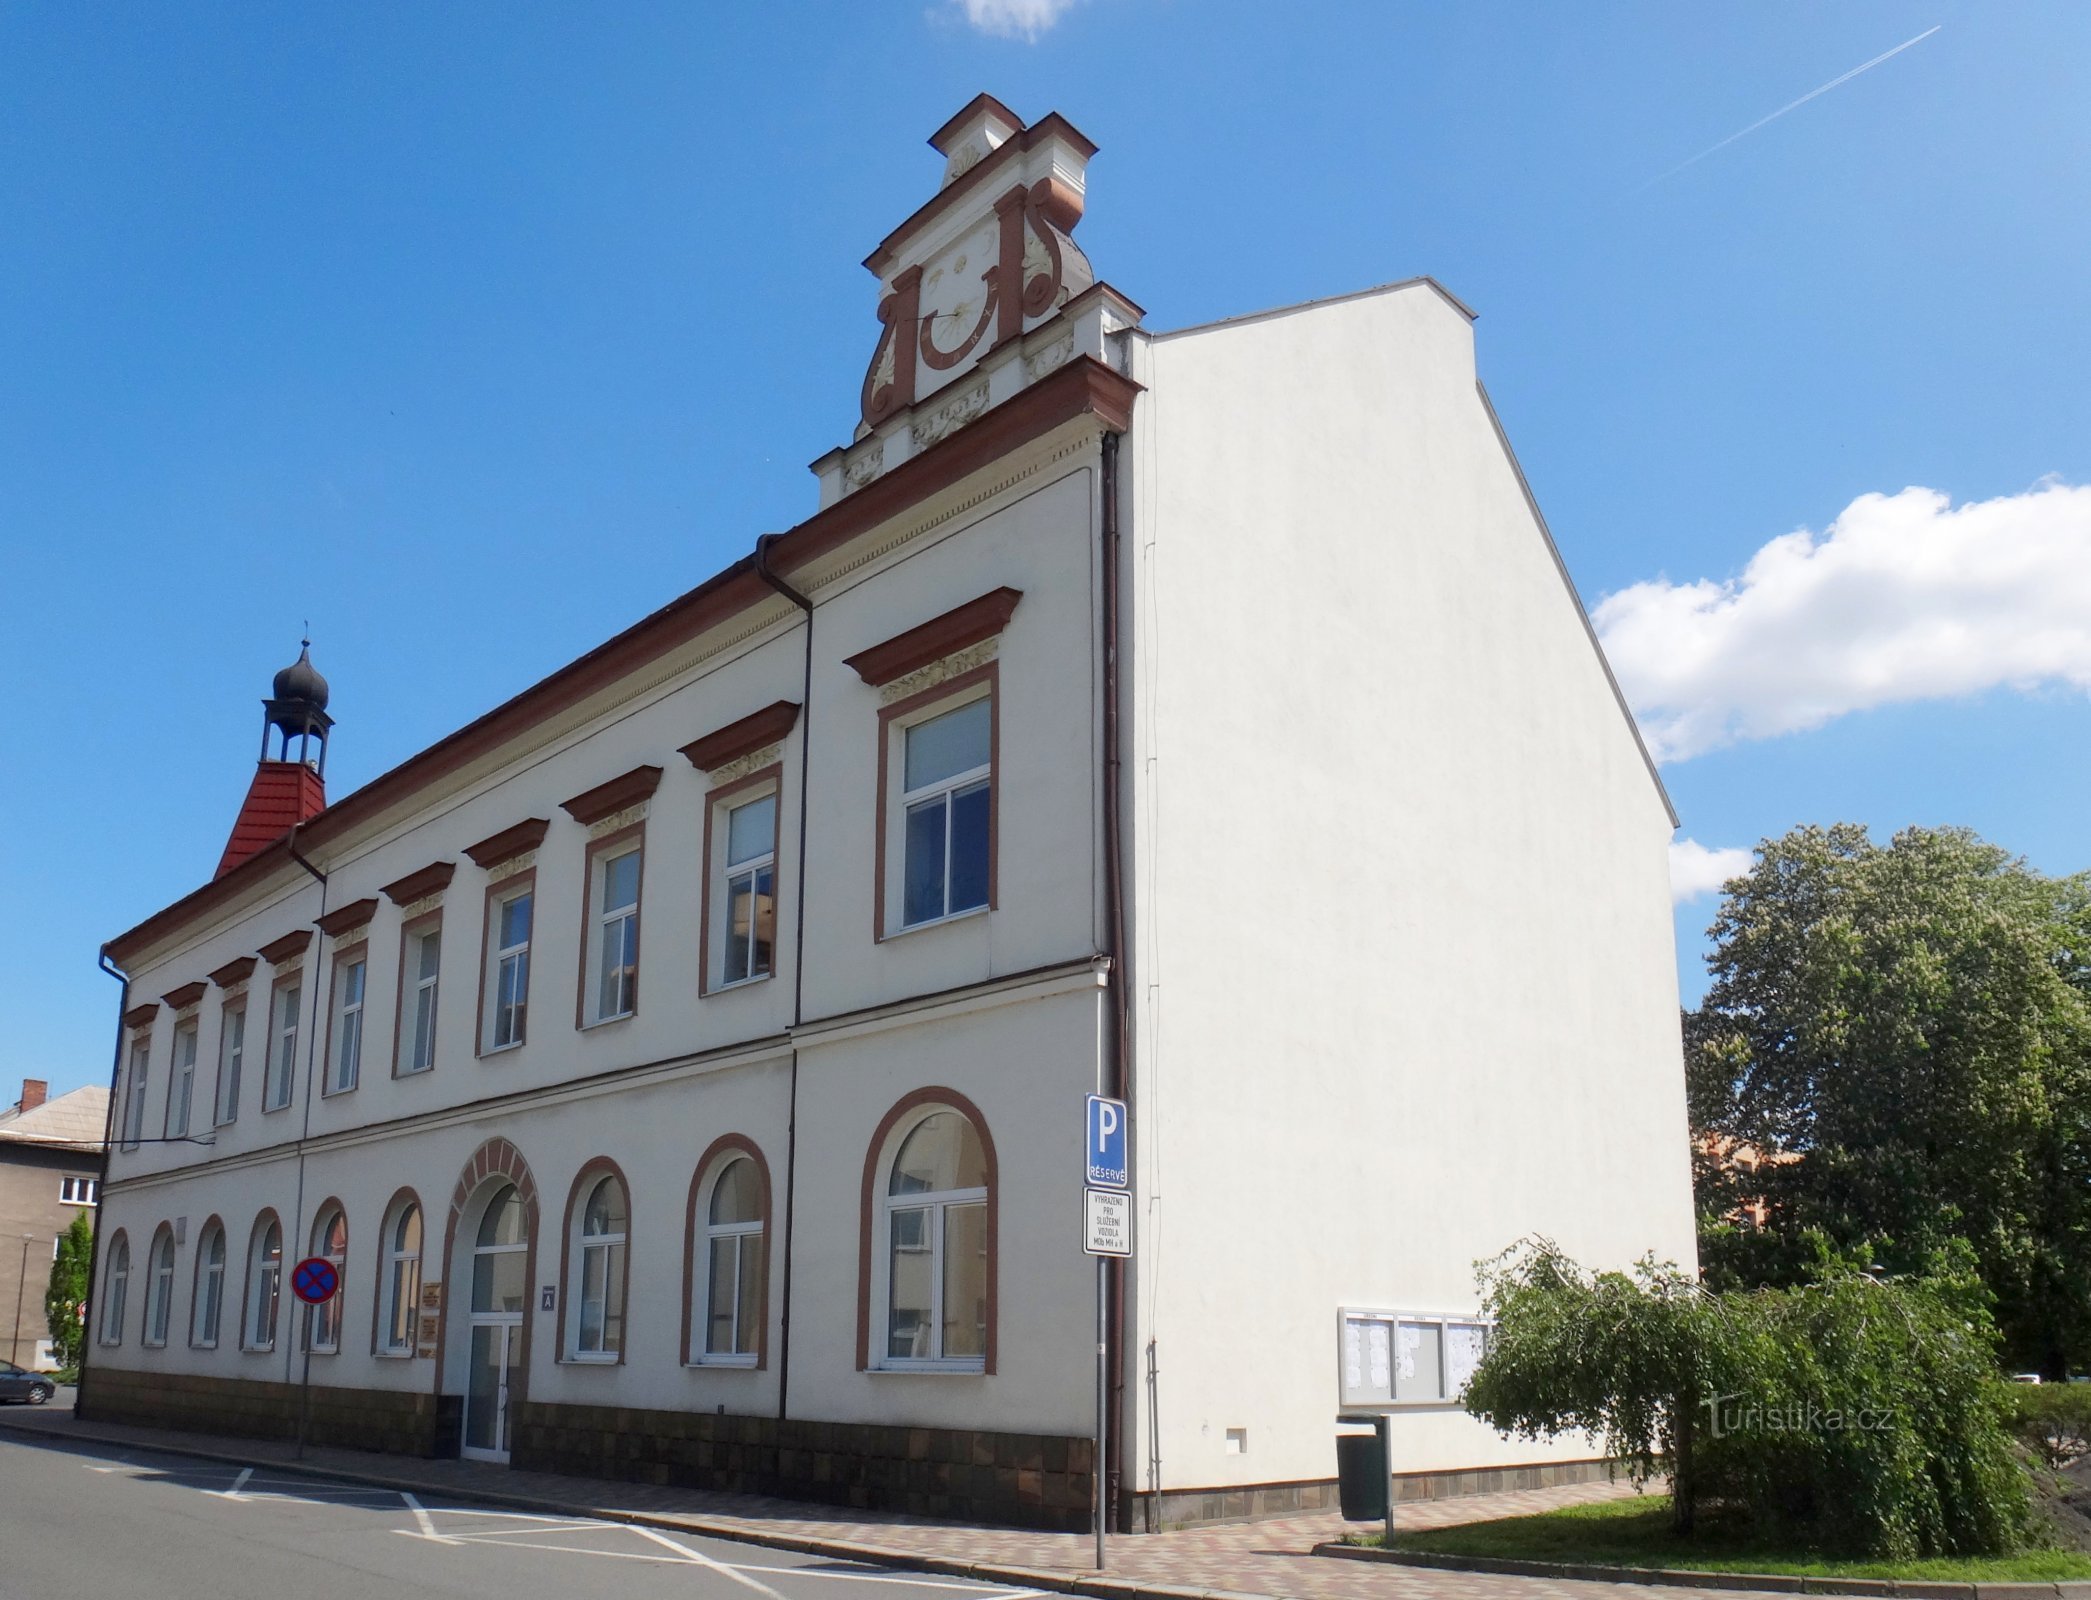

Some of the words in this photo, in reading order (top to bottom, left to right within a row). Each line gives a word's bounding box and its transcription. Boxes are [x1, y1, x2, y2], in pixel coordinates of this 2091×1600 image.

[1099, 1102, 1117, 1153] P
[1090, 1165, 1125, 1181] RÉSERVÉ
[1094, 1195, 1123, 1206] VYHRAZENO
[1103, 1206, 1114, 1215] PRO
[1096, 1216, 1121, 1227] SLUŽEBNÍ
[1097, 1227, 1119, 1237] VOZIDLA
[544, 1295, 551, 1308] A
